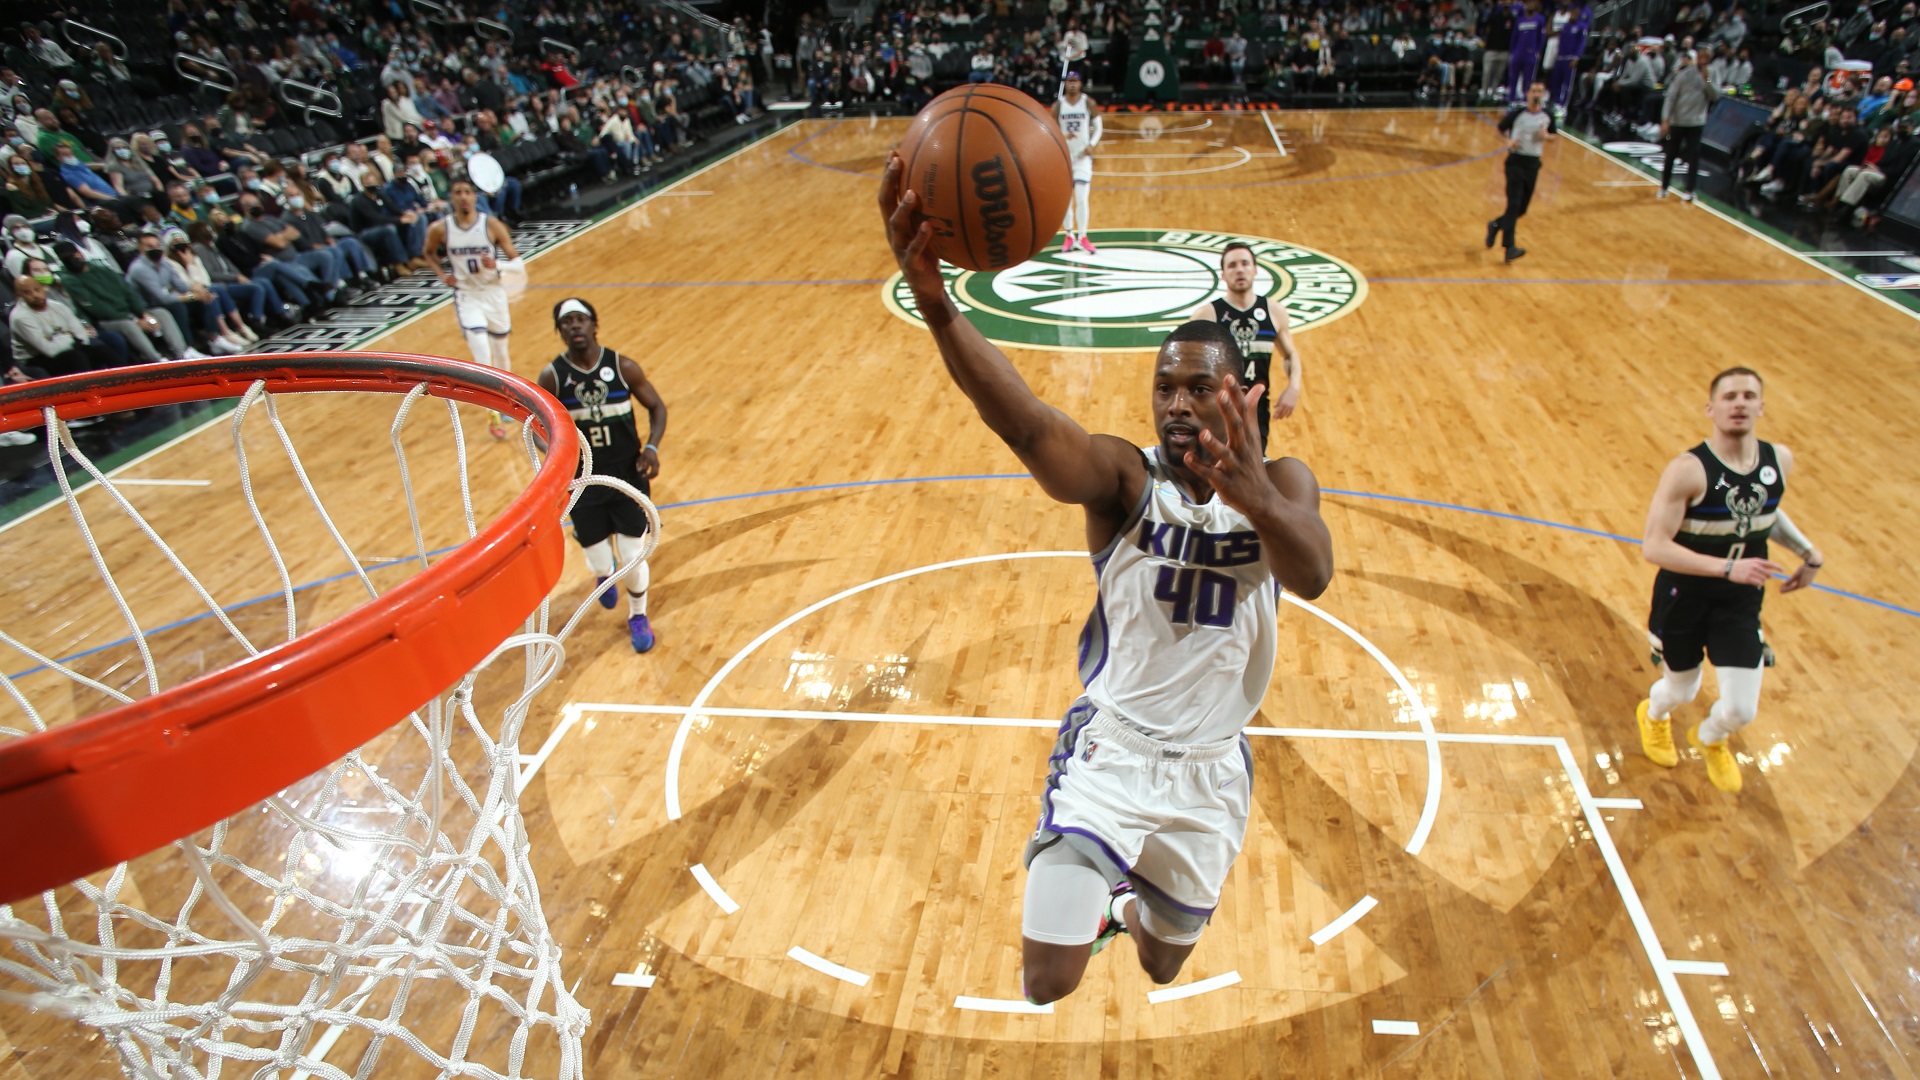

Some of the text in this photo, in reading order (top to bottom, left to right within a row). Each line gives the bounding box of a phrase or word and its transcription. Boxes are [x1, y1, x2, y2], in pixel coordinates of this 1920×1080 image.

[1066, 121, 1081, 132] 22
[971, 154, 1015, 268] Wilson
[467, 259, 479, 273] 0
[1158, 230, 1354, 329] BUCKS BASKET
[1245, 361, 1256, 380] 4
[589, 425, 612, 447] 21
[1137, 517, 1261, 567] KINGS
[1153, 564, 1238, 628] 40
